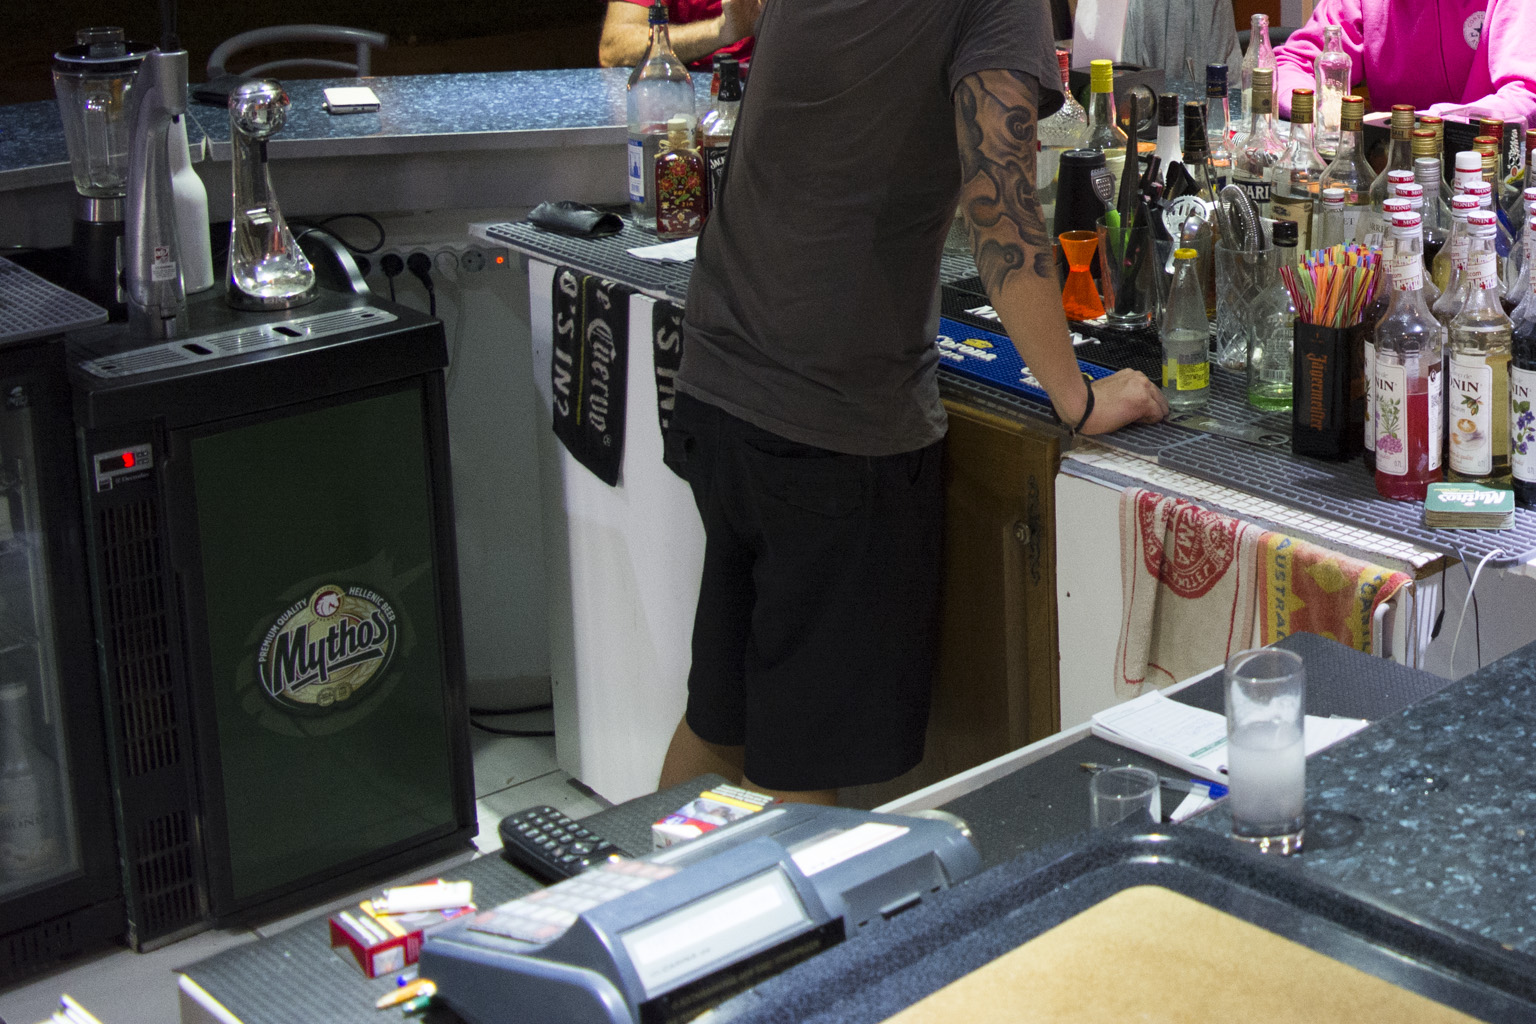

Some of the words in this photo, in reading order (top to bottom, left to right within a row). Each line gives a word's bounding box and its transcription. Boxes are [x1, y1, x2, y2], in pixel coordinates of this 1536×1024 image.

[586, 317, 618, 433] Cuervo
[258, 625, 279, 663] PREMIUM
[276, 598, 307, 626] QUALITY
[349, 586, 384, 607] HELLENIC
[380, 601, 397, 623] BEER
[271, 609, 390, 697] Mythos
